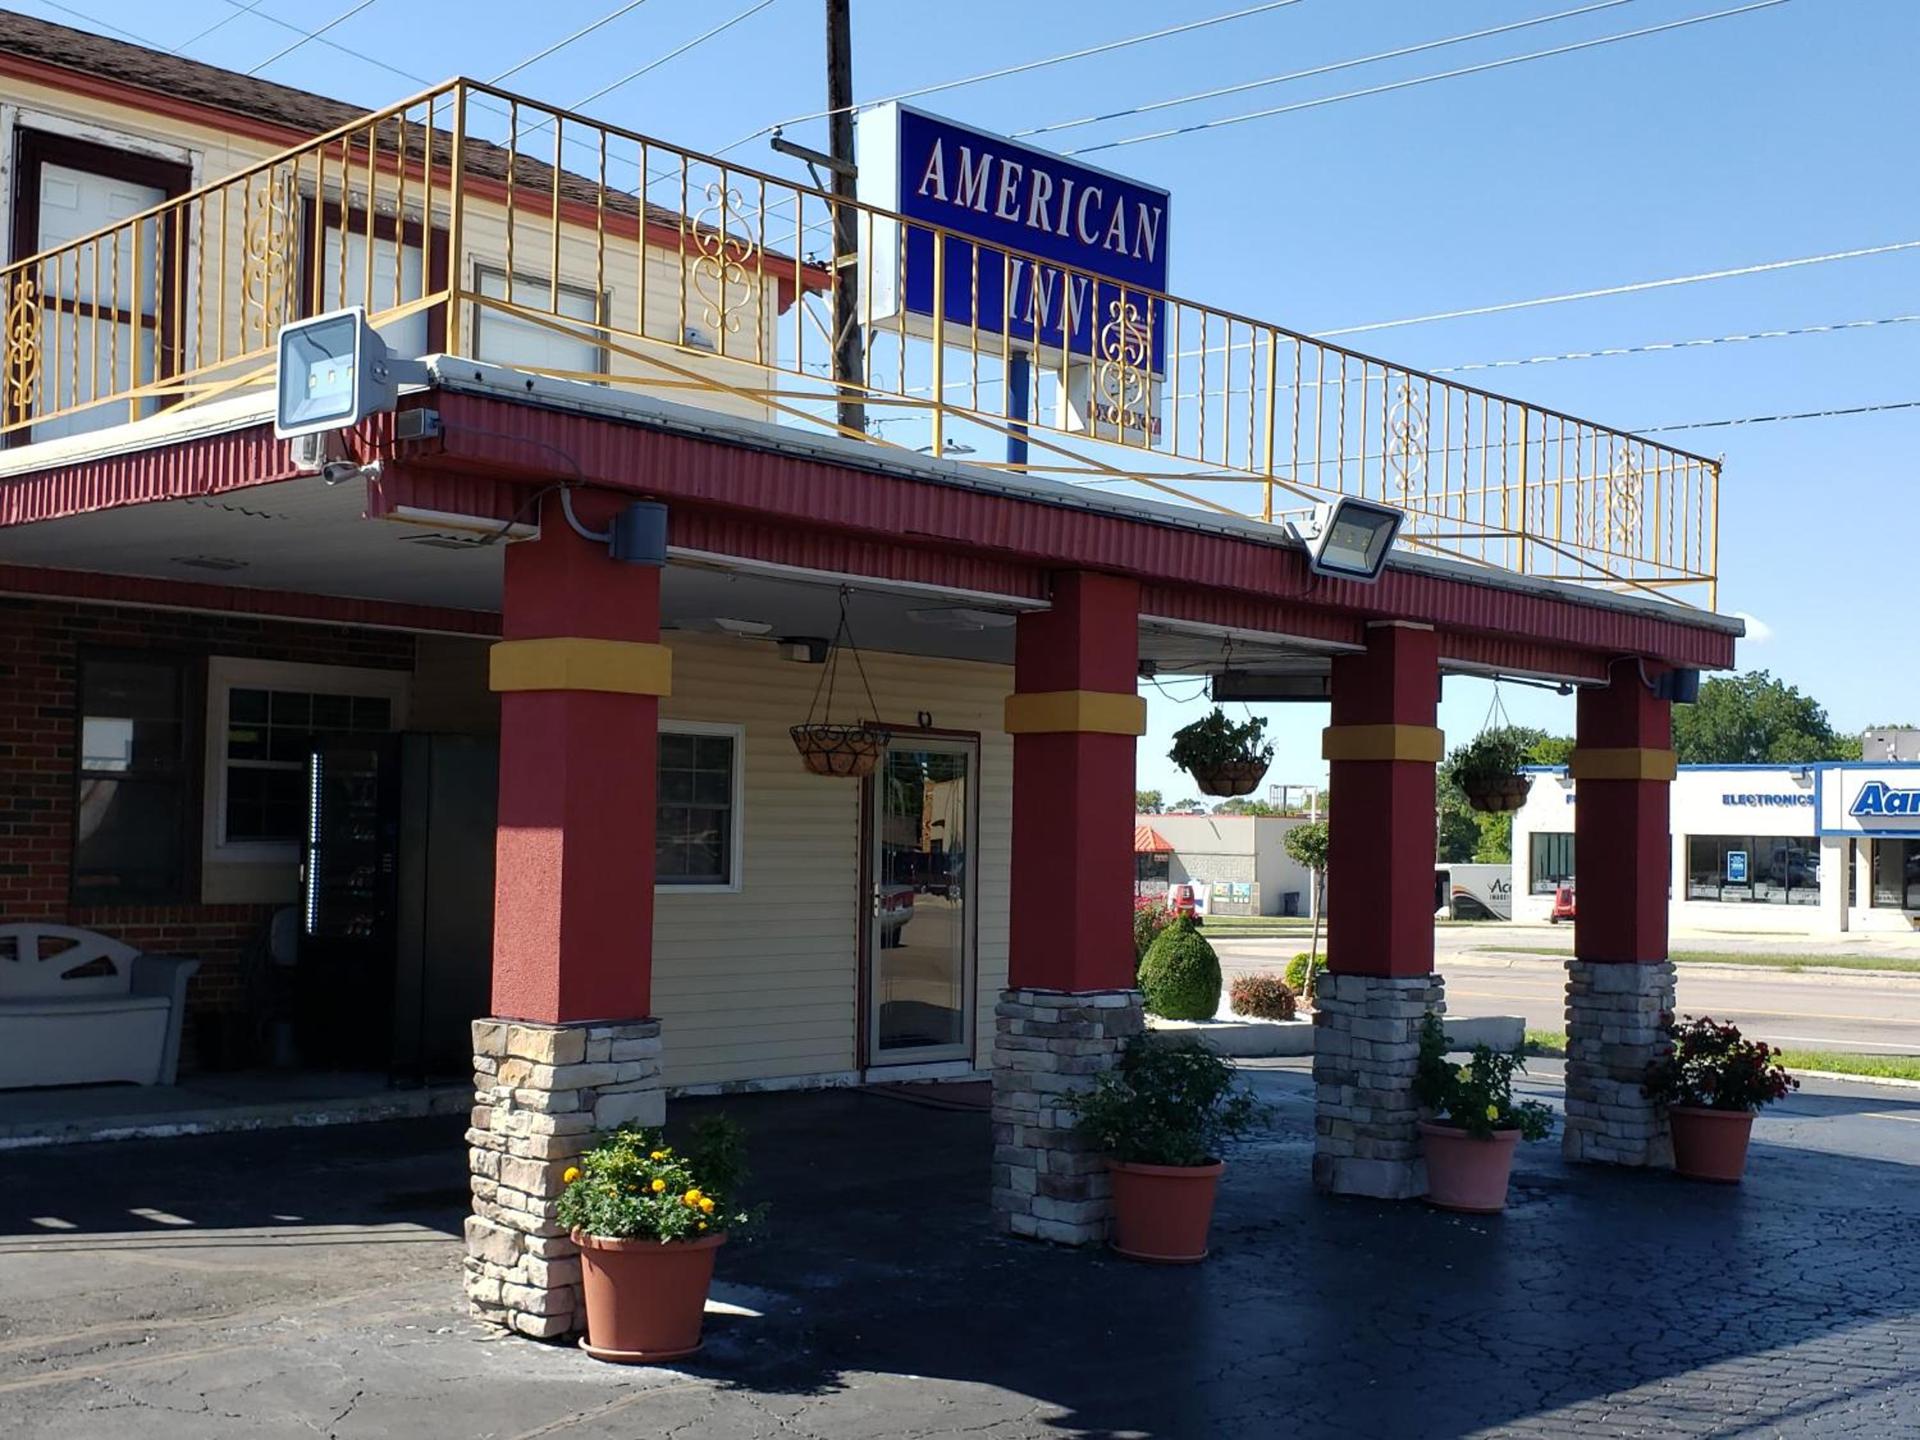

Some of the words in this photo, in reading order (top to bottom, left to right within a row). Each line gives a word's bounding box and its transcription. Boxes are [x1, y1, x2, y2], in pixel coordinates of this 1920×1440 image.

[918, 137, 1162, 263] AMERICAN
[1008, 258, 1088, 336] INN
[1721, 794, 1815, 807] ELECTRONICS
